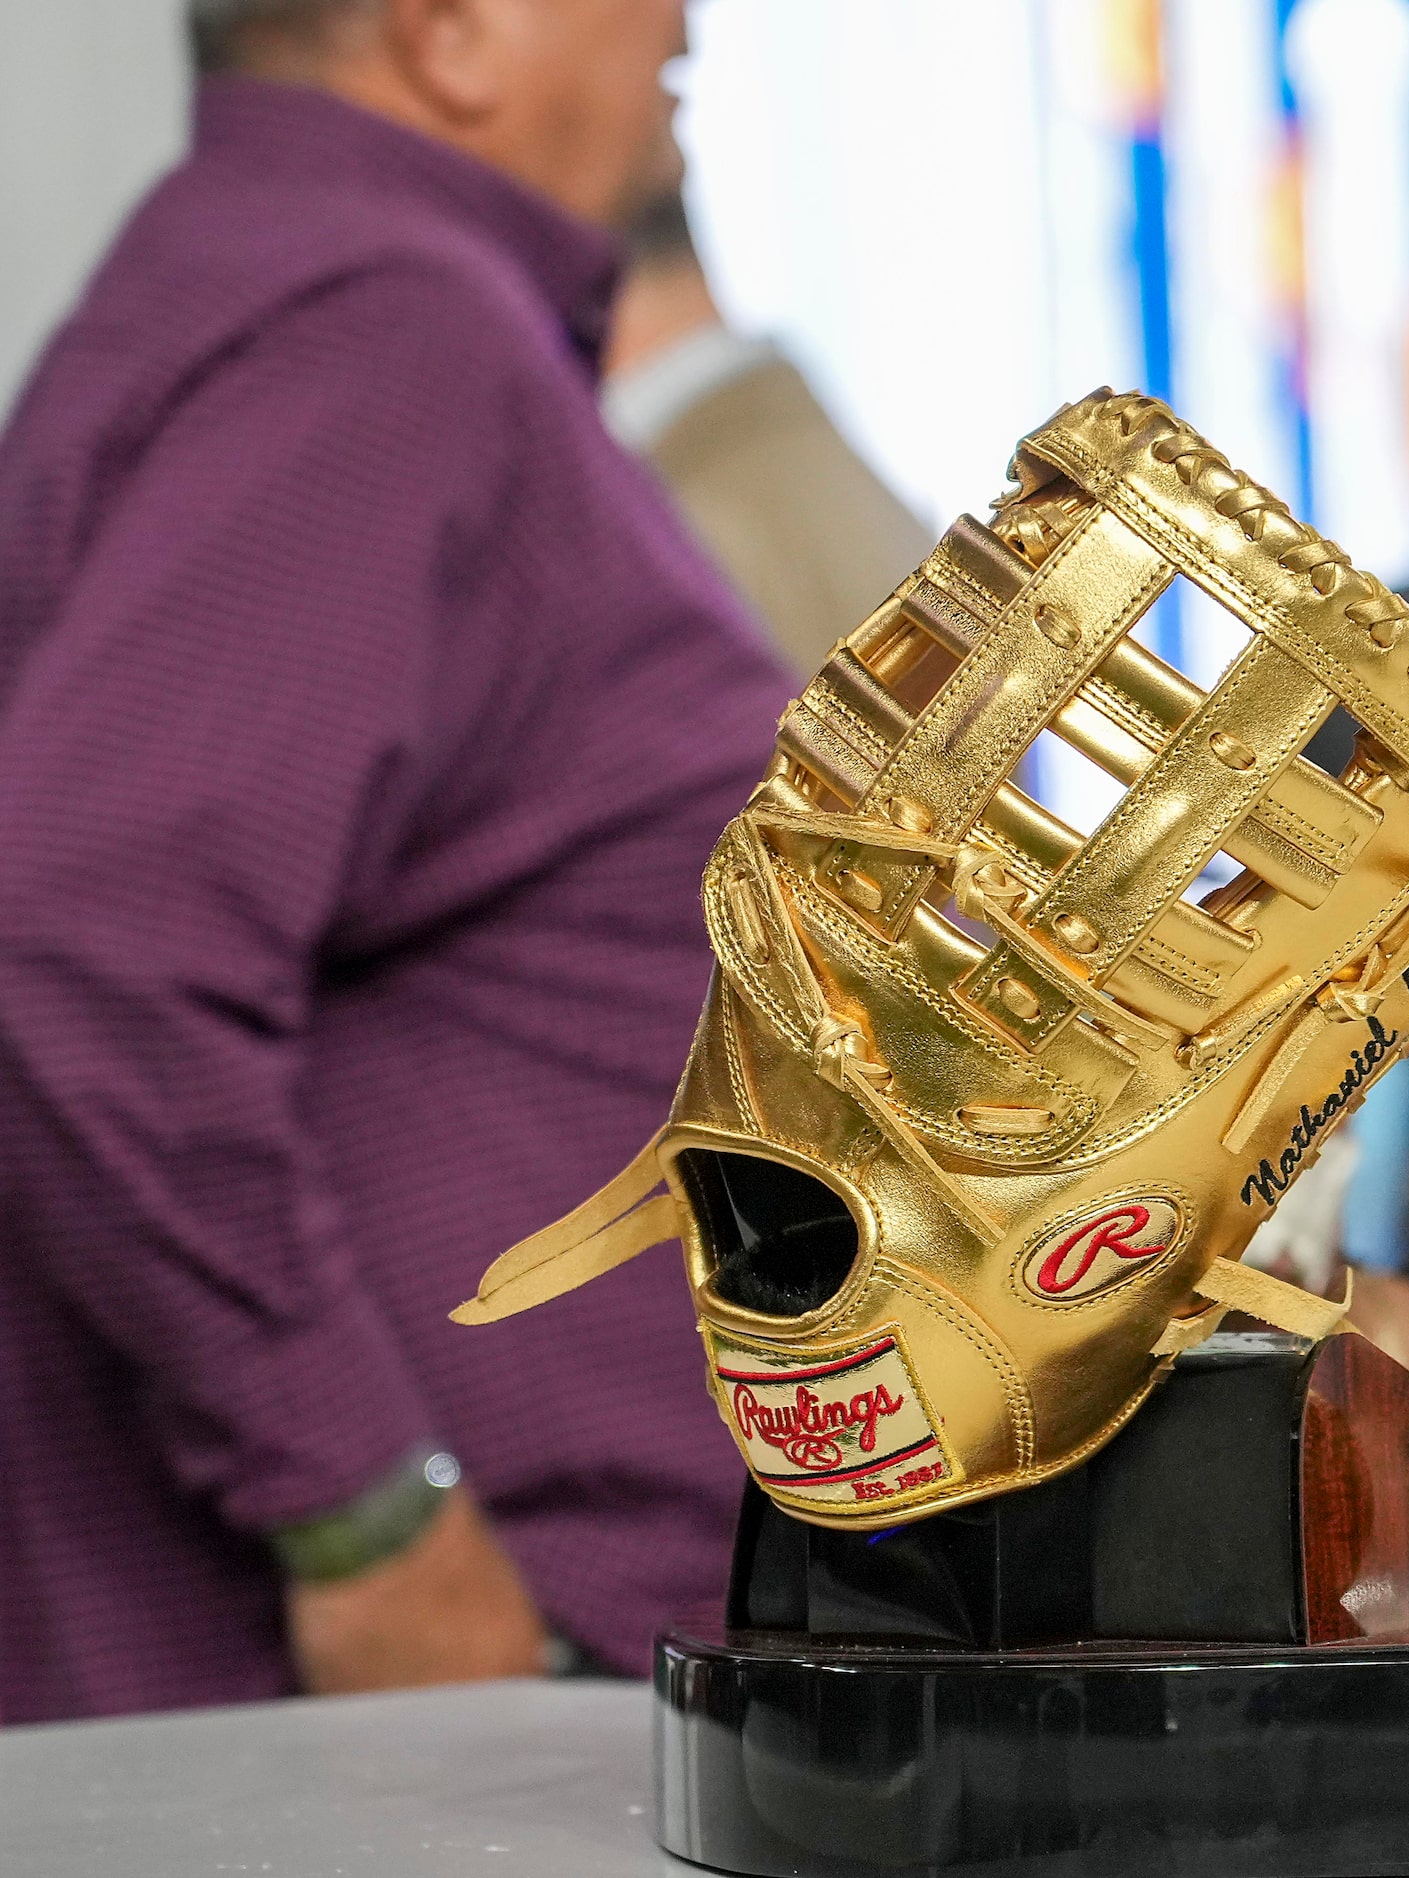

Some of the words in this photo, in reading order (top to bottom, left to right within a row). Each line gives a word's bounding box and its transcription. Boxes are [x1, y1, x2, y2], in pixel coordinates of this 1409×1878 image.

[1241, 1016, 1398, 1206] Nathaniel
[1037, 1205, 1166, 1293] R
[734, 1383, 904, 1452] Rawlings
